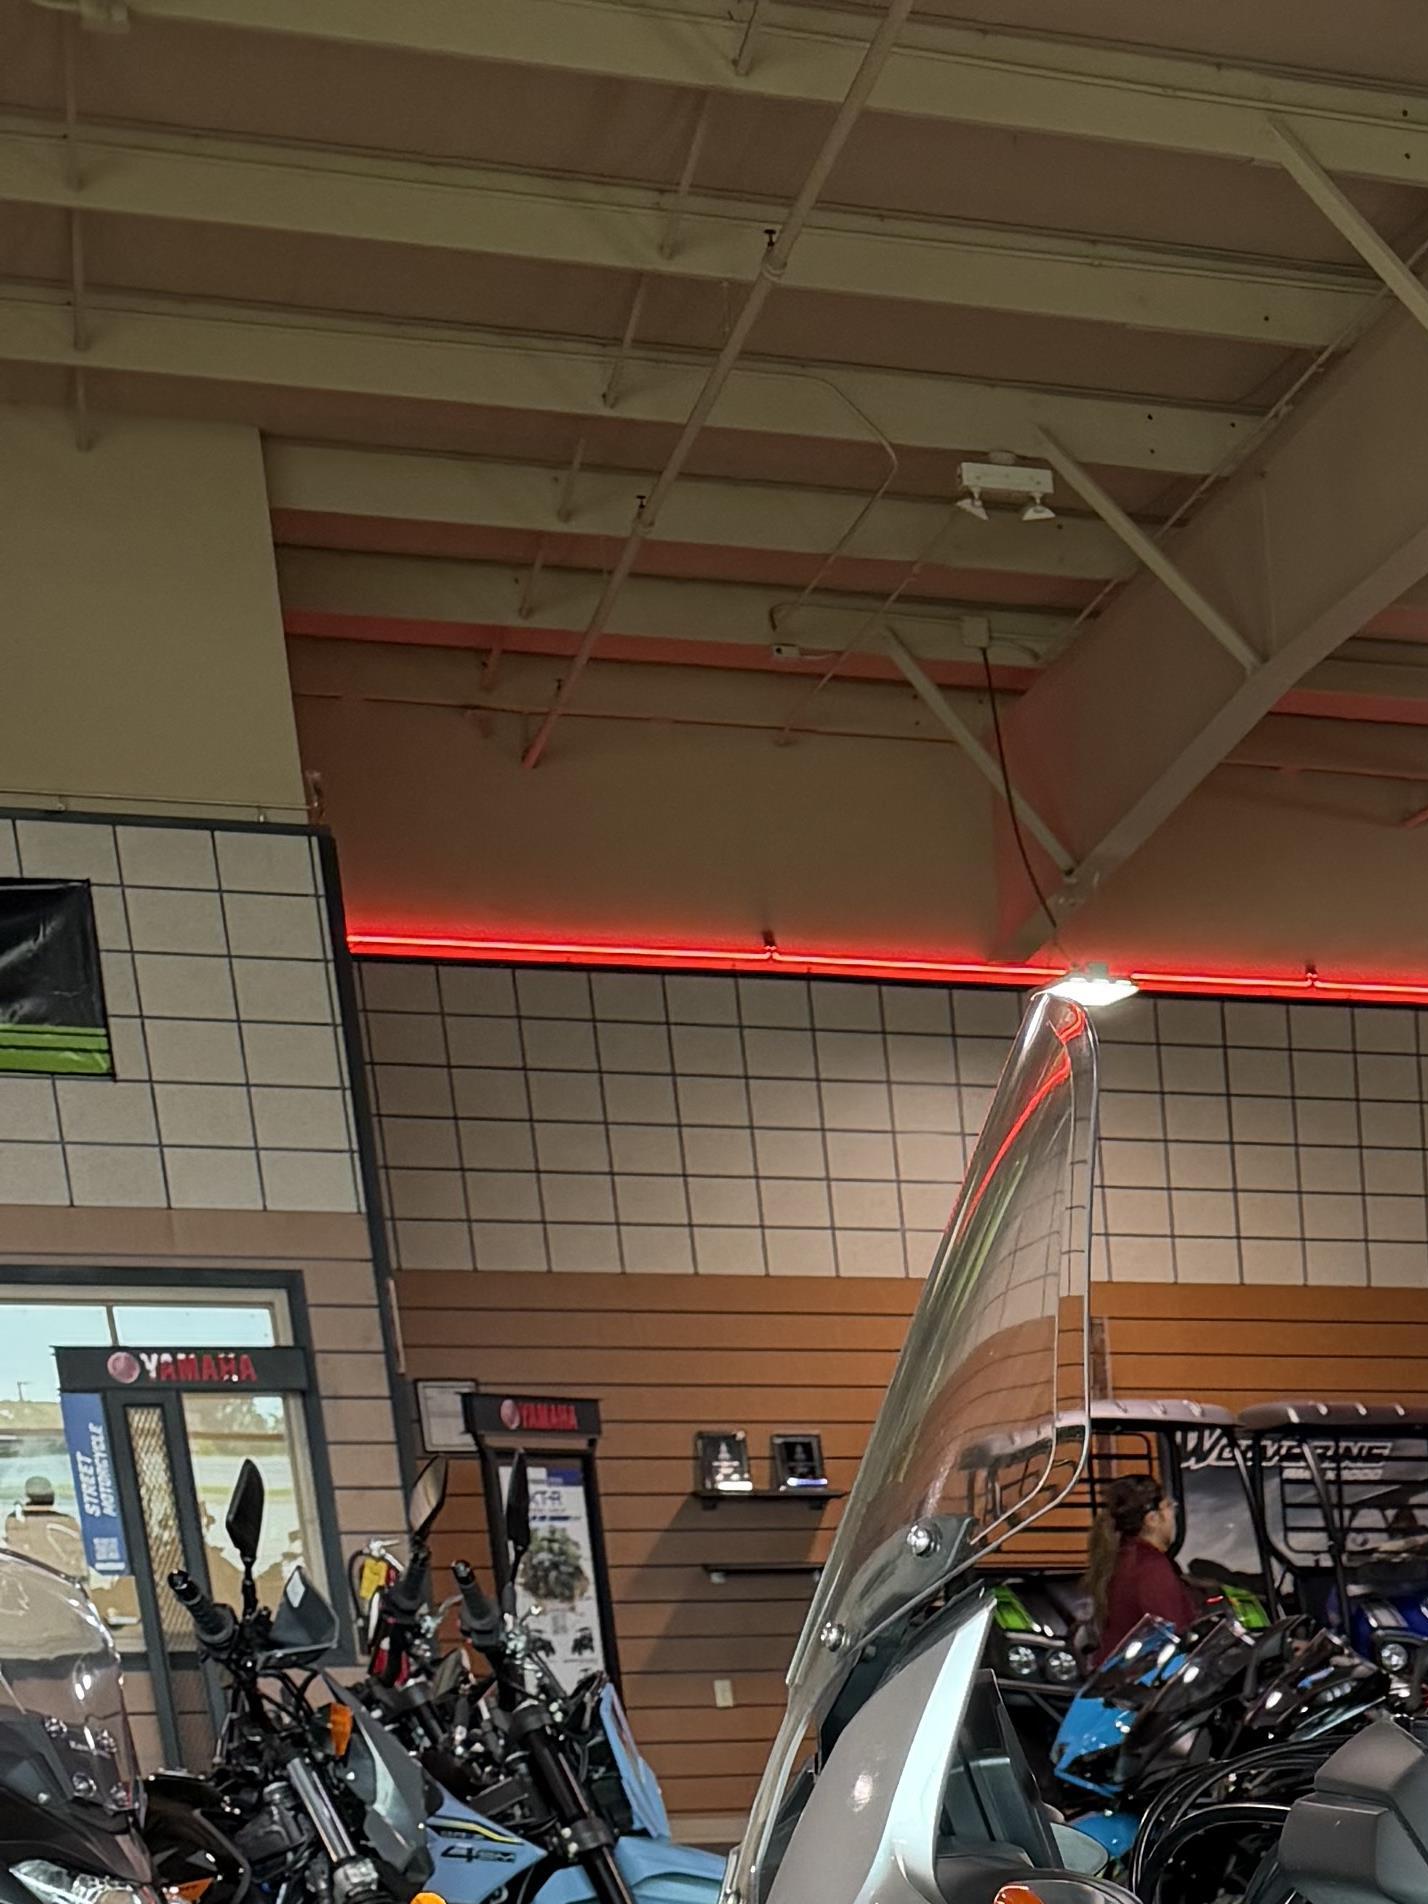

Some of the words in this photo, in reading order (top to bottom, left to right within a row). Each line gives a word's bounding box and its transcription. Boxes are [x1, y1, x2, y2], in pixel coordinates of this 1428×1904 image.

[140, 1353, 258, 1382] YAMAHA
[519, 1403, 578, 1430] YAMAHA
[77, 1451, 101, 1518] STREET
